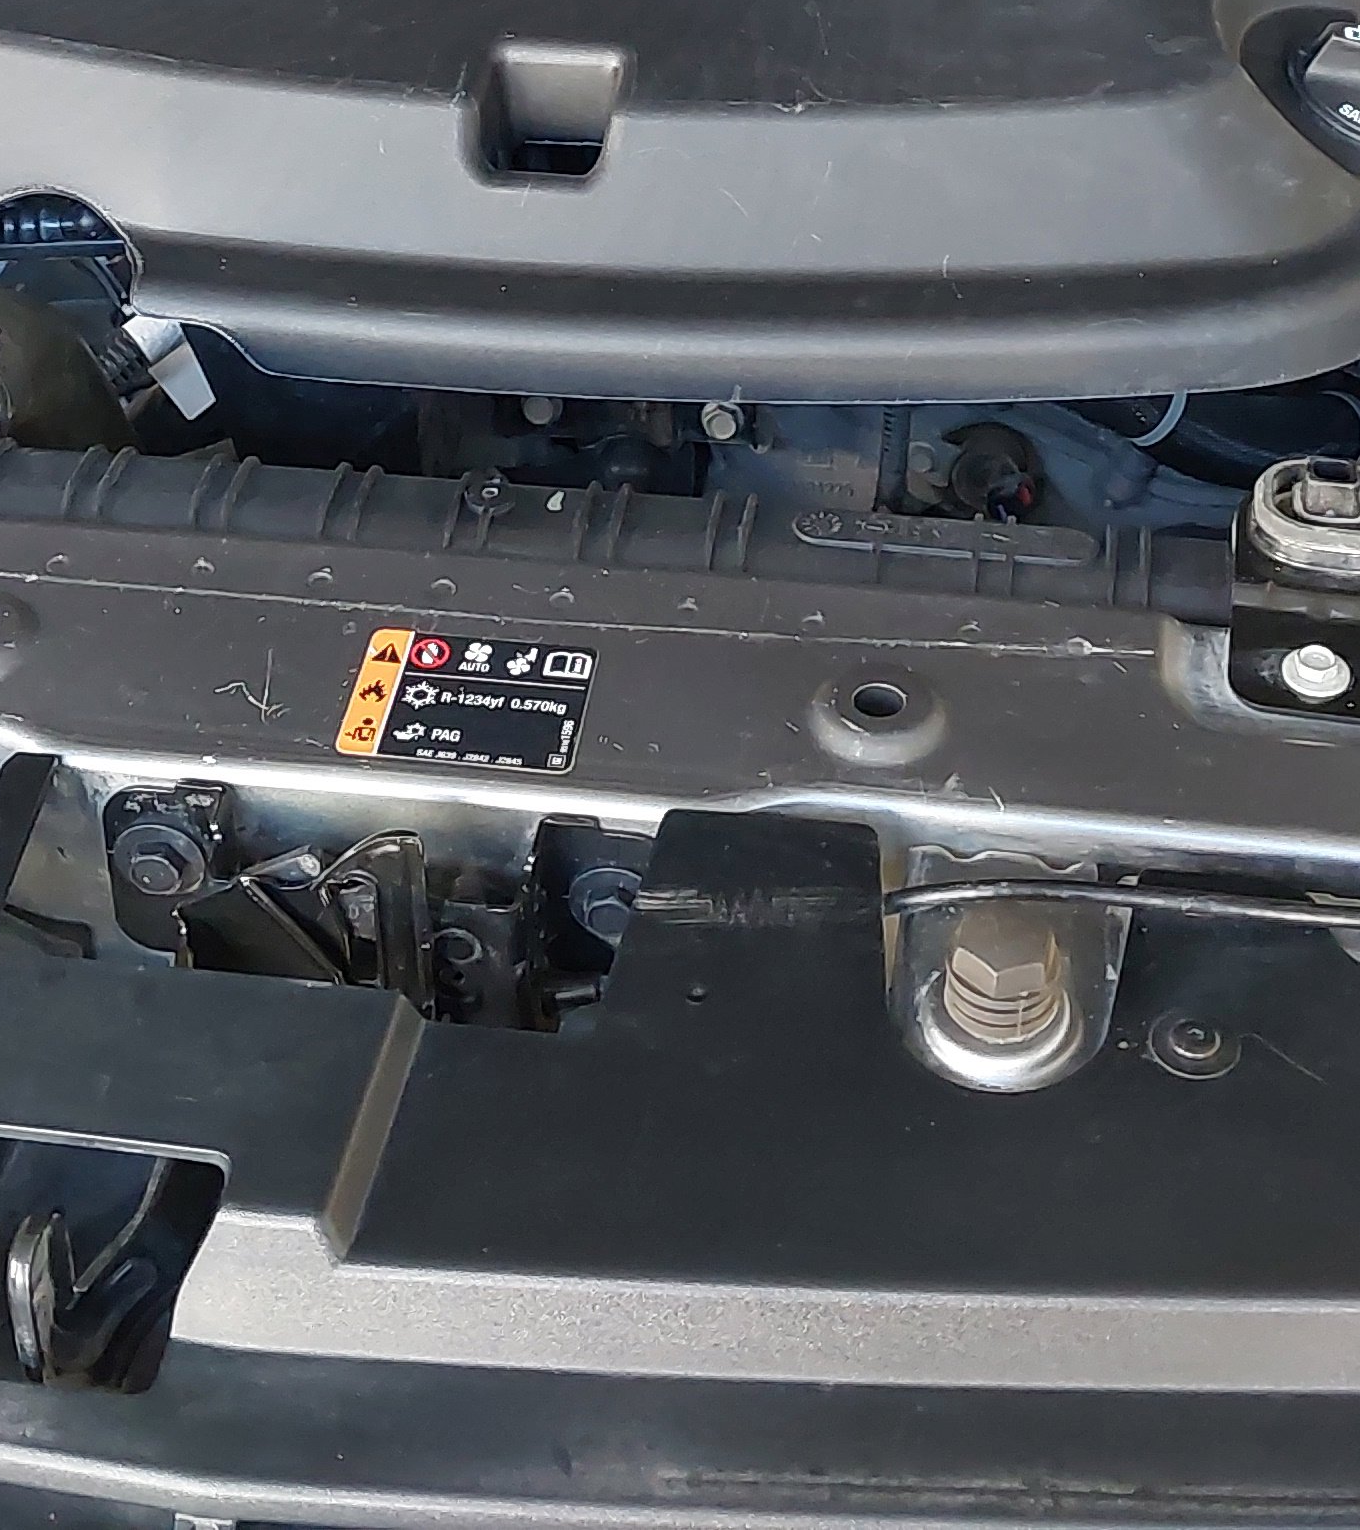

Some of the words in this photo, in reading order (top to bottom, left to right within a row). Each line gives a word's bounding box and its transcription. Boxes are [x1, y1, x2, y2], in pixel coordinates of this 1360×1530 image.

[458, 661, 490, 673] AUTO
[440, 691, 504, 709] R-1234yf
[511, 698, 566, 715] 0.570kg
[430, 728, 461, 743] PAG
